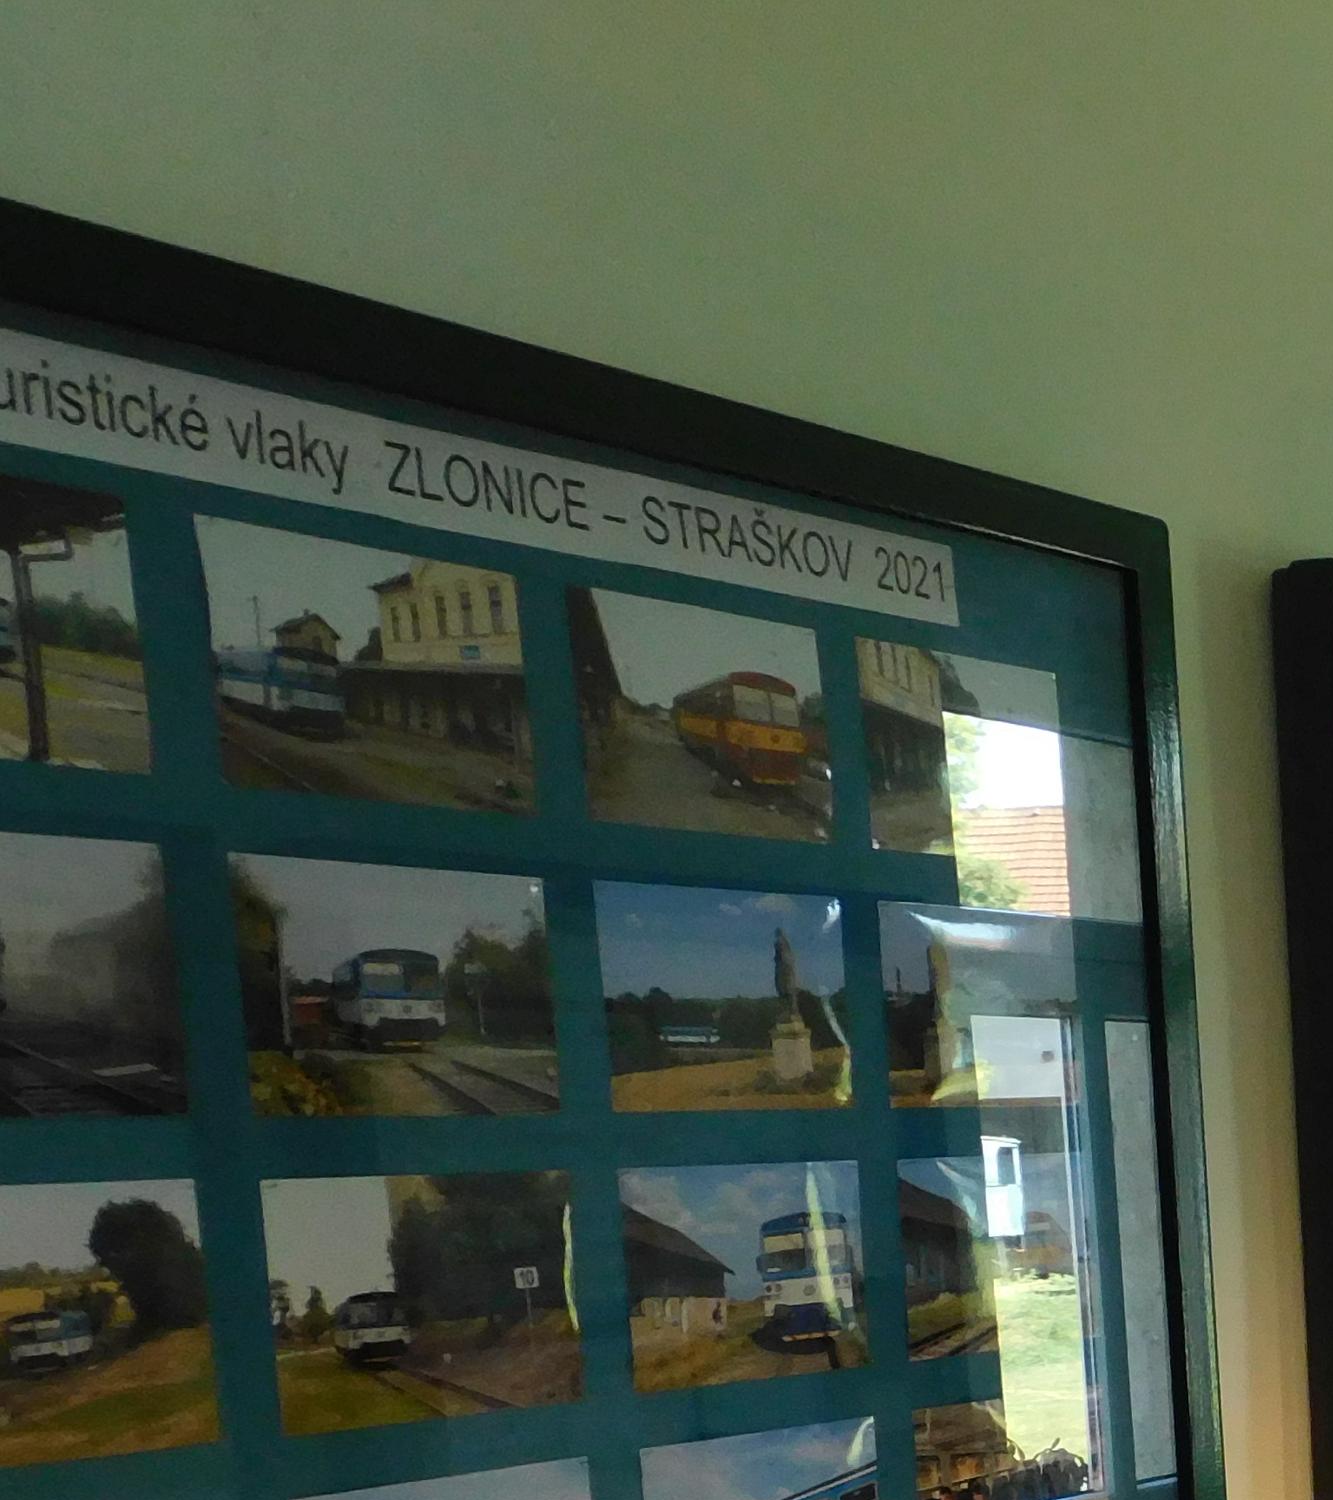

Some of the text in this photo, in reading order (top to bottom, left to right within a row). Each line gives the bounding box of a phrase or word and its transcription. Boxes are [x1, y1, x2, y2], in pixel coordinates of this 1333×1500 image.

[229, 408, 350, 495] vlaky
[387, 441, 590, 532] ZLONICE
[642, 496, 854, 584] STRAŠKOV
[875, 547, 948, 602] 2021
